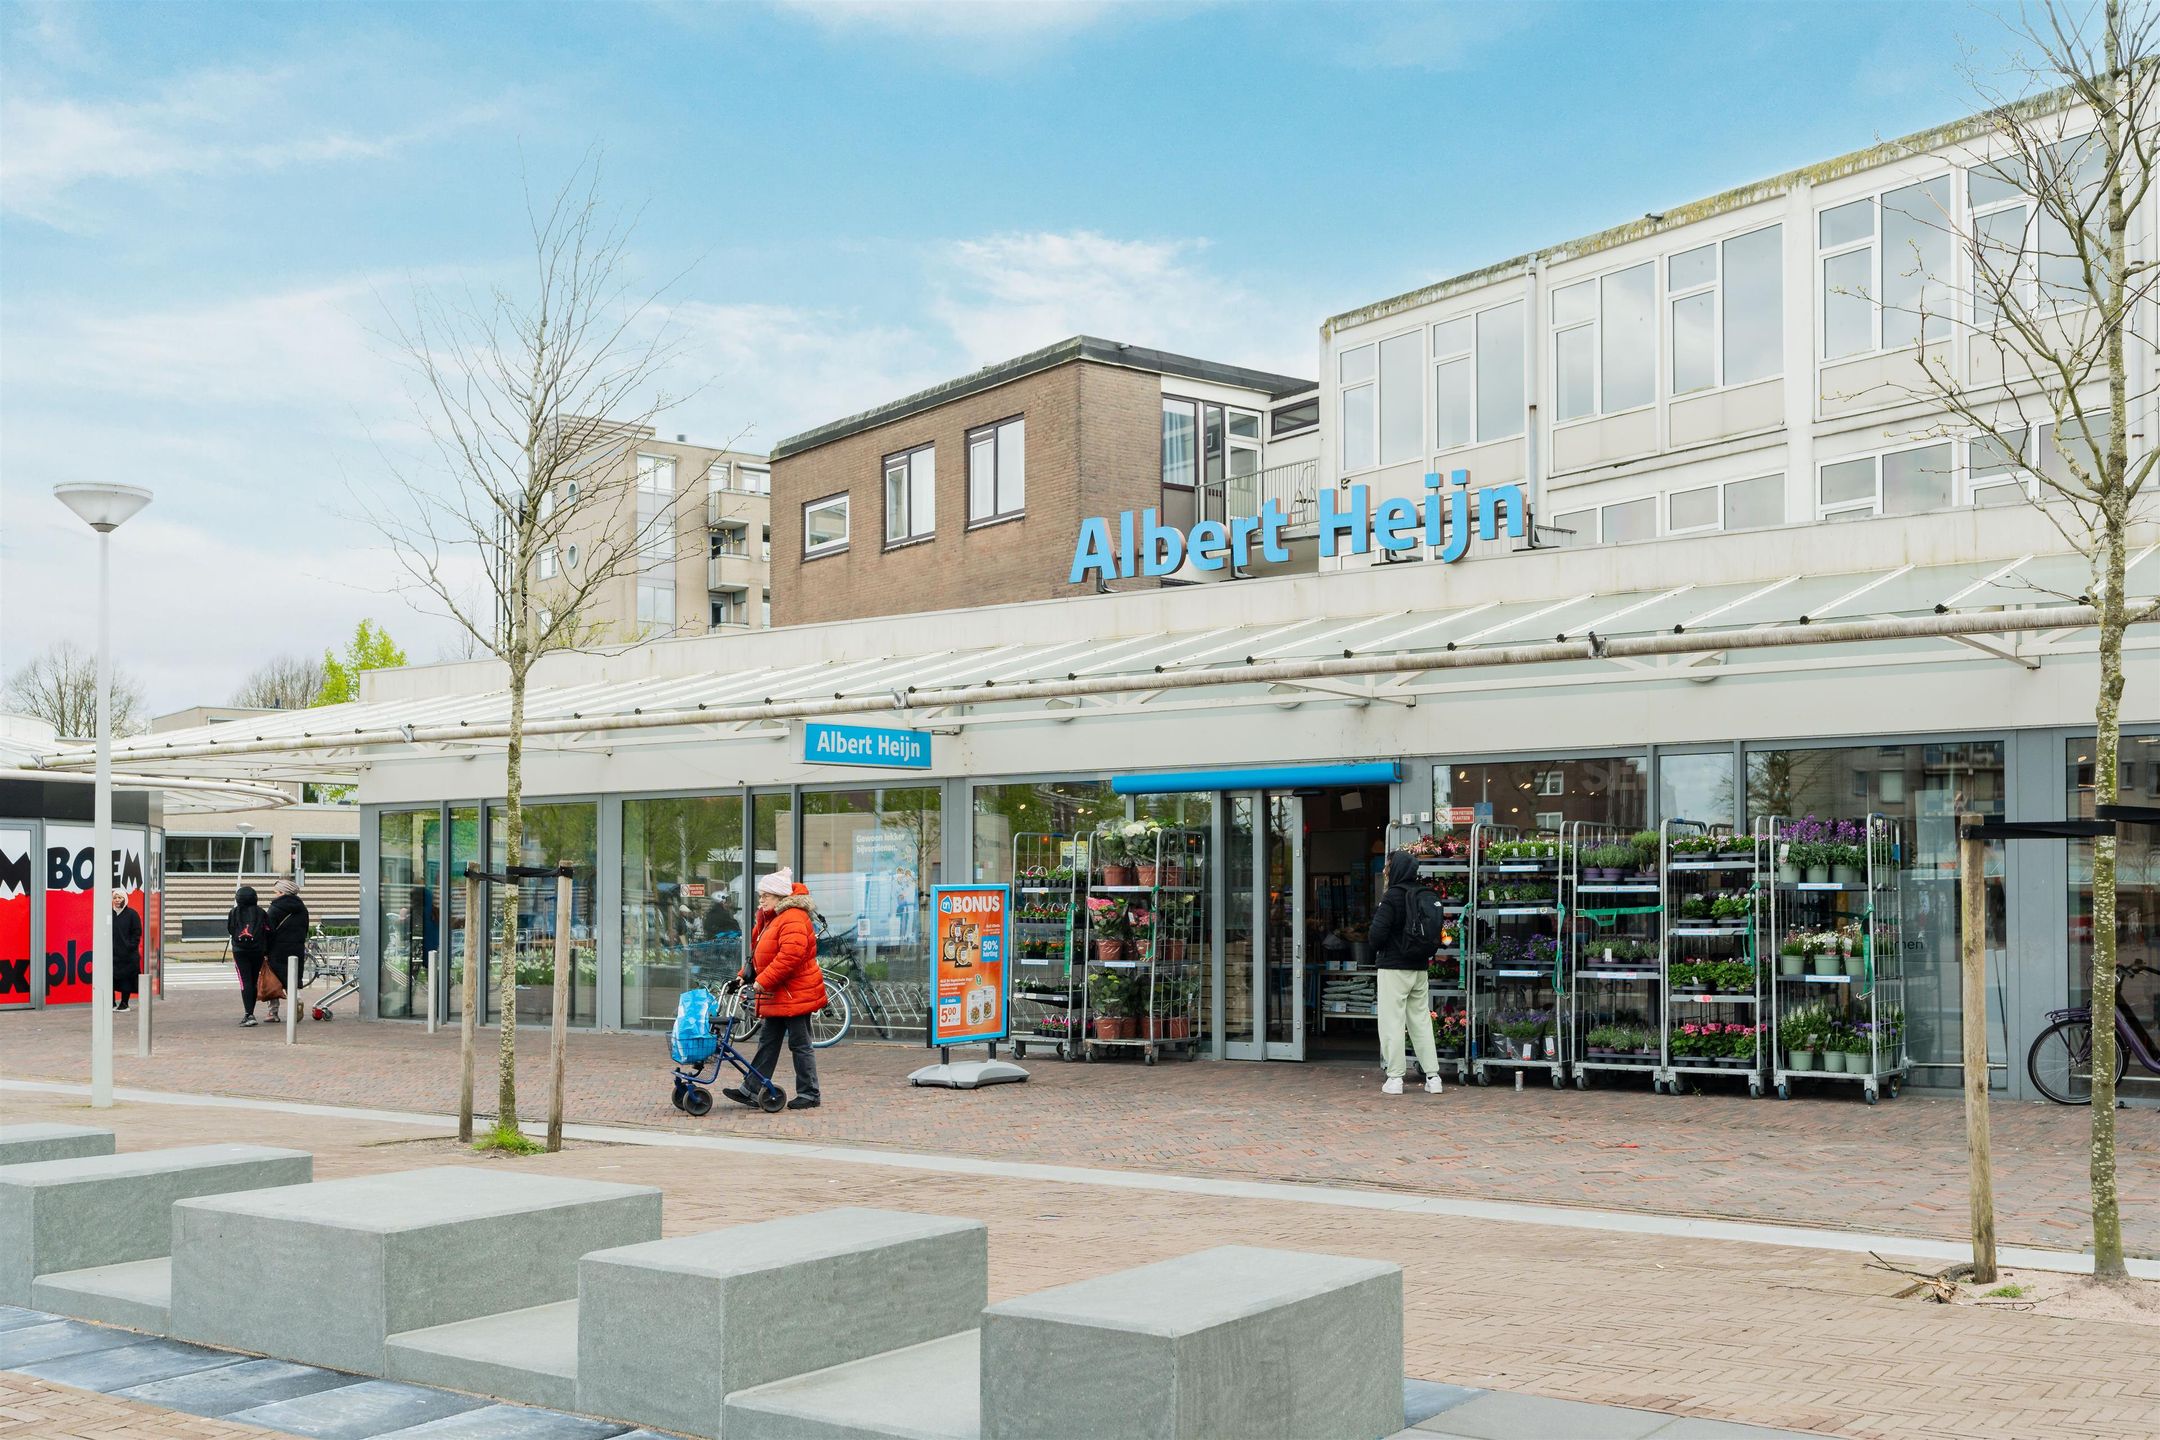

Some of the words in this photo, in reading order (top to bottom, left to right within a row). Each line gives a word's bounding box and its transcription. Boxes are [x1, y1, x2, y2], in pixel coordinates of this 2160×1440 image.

[1068, 497, 1294, 584] Albert
[1319, 469, 1527, 564] Heijn
[817, 731, 872, 755] Albert
[878, 735, 920, 762] Heijn
[953, 895, 1000, 913] BONUS
[982, 940, 999, 951] 50%
